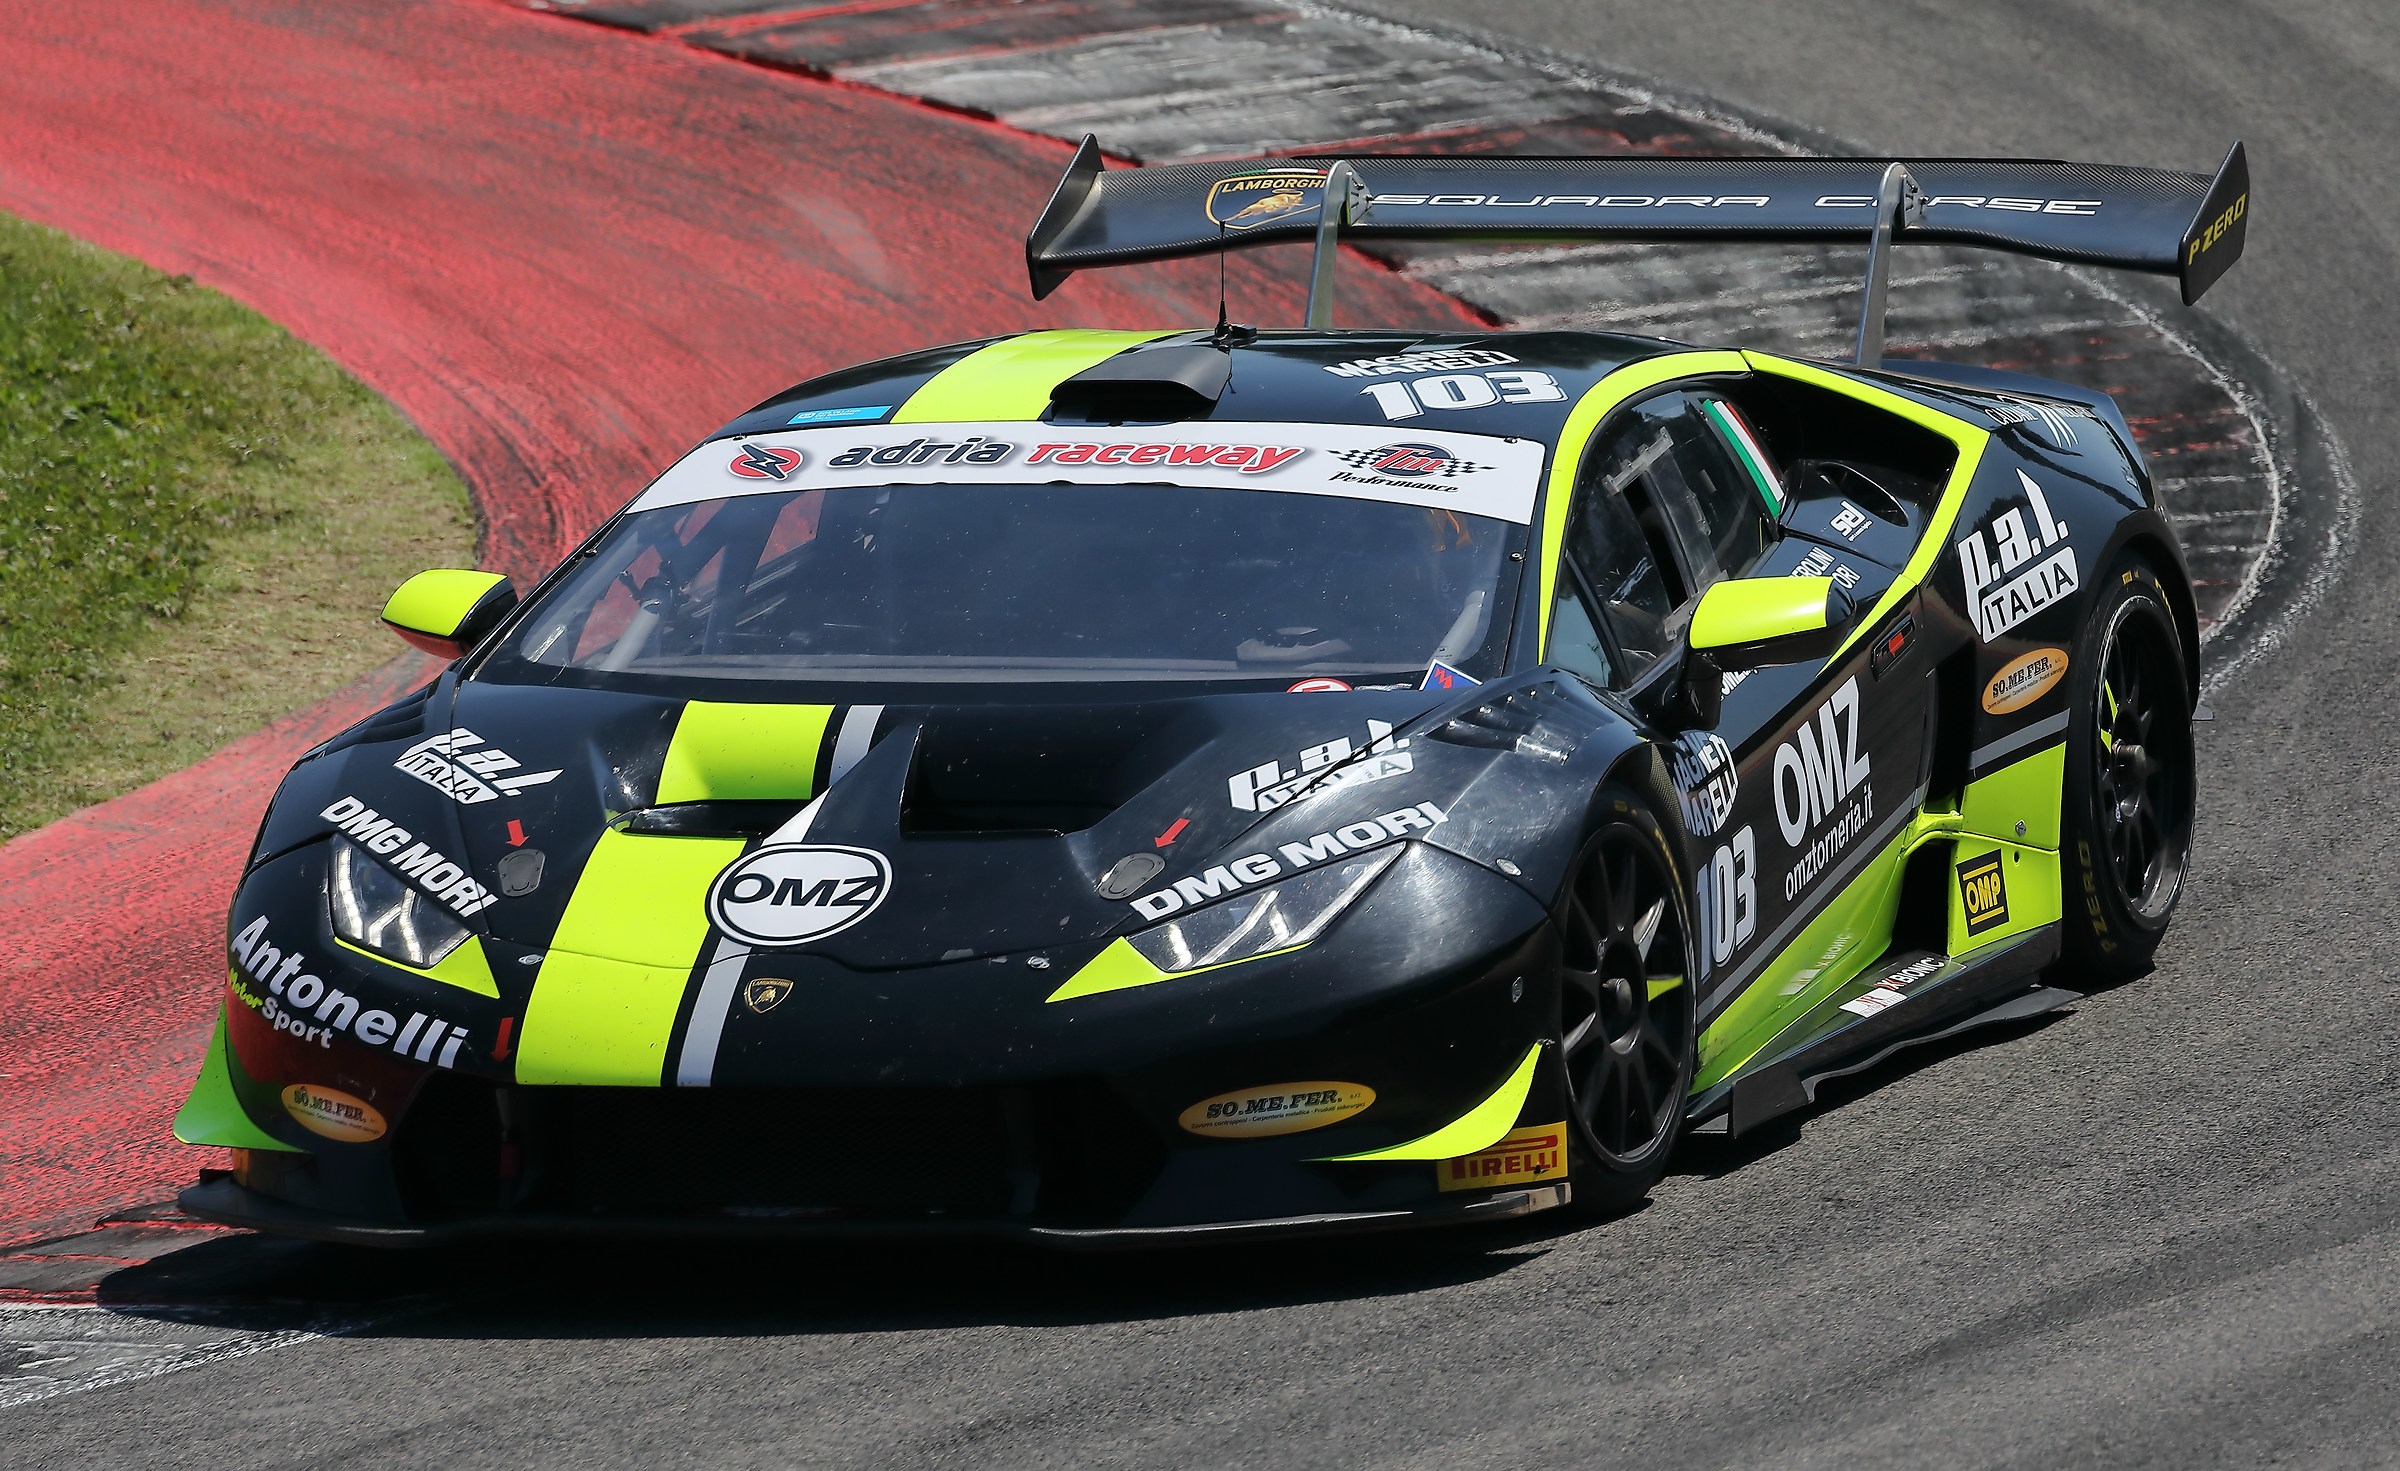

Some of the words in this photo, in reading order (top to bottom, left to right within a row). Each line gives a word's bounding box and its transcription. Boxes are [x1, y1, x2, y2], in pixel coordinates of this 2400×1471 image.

[1371, 194, 1771, 208] SQUADRA
[1814, 195, 2102, 215] CRSE
[2188, 238, 2200, 266] P
[2202, 193, 2247, 253] ZERO
[1324, 352, 1521, 378] MARELLI
[1359, 371, 1568, 422] 103
[829, 437, 1014, 465] adria
[1026, 441, 1305, 473] raceway
[1328, 470, 1460, 493] Performance
[1984, 562, 2075, 635] ITALIA
[404, 755, 481, 801] ITALIA
[1773, 674, 1871, 848] OMZ
[319, 795, 413, 855] DMG
[388, 841, 499, 918] MORI
[1130, 852, 1283, 922] DMG
[1277, 800, 1450, 868] MORI
[1785, 781, 1874, 902] omztorneria.it
[724, 873, 880, 907] OMZ
[1696, 824, 1757, 984] 103
[1966, 872, 2001, 914] OMP
[231, 914, 469, 1069] Antonelli
[1206, 1089, 1343, 1119] SO.ME.FER.
[1452, 1134, 1559, 1180] PIRELLI
